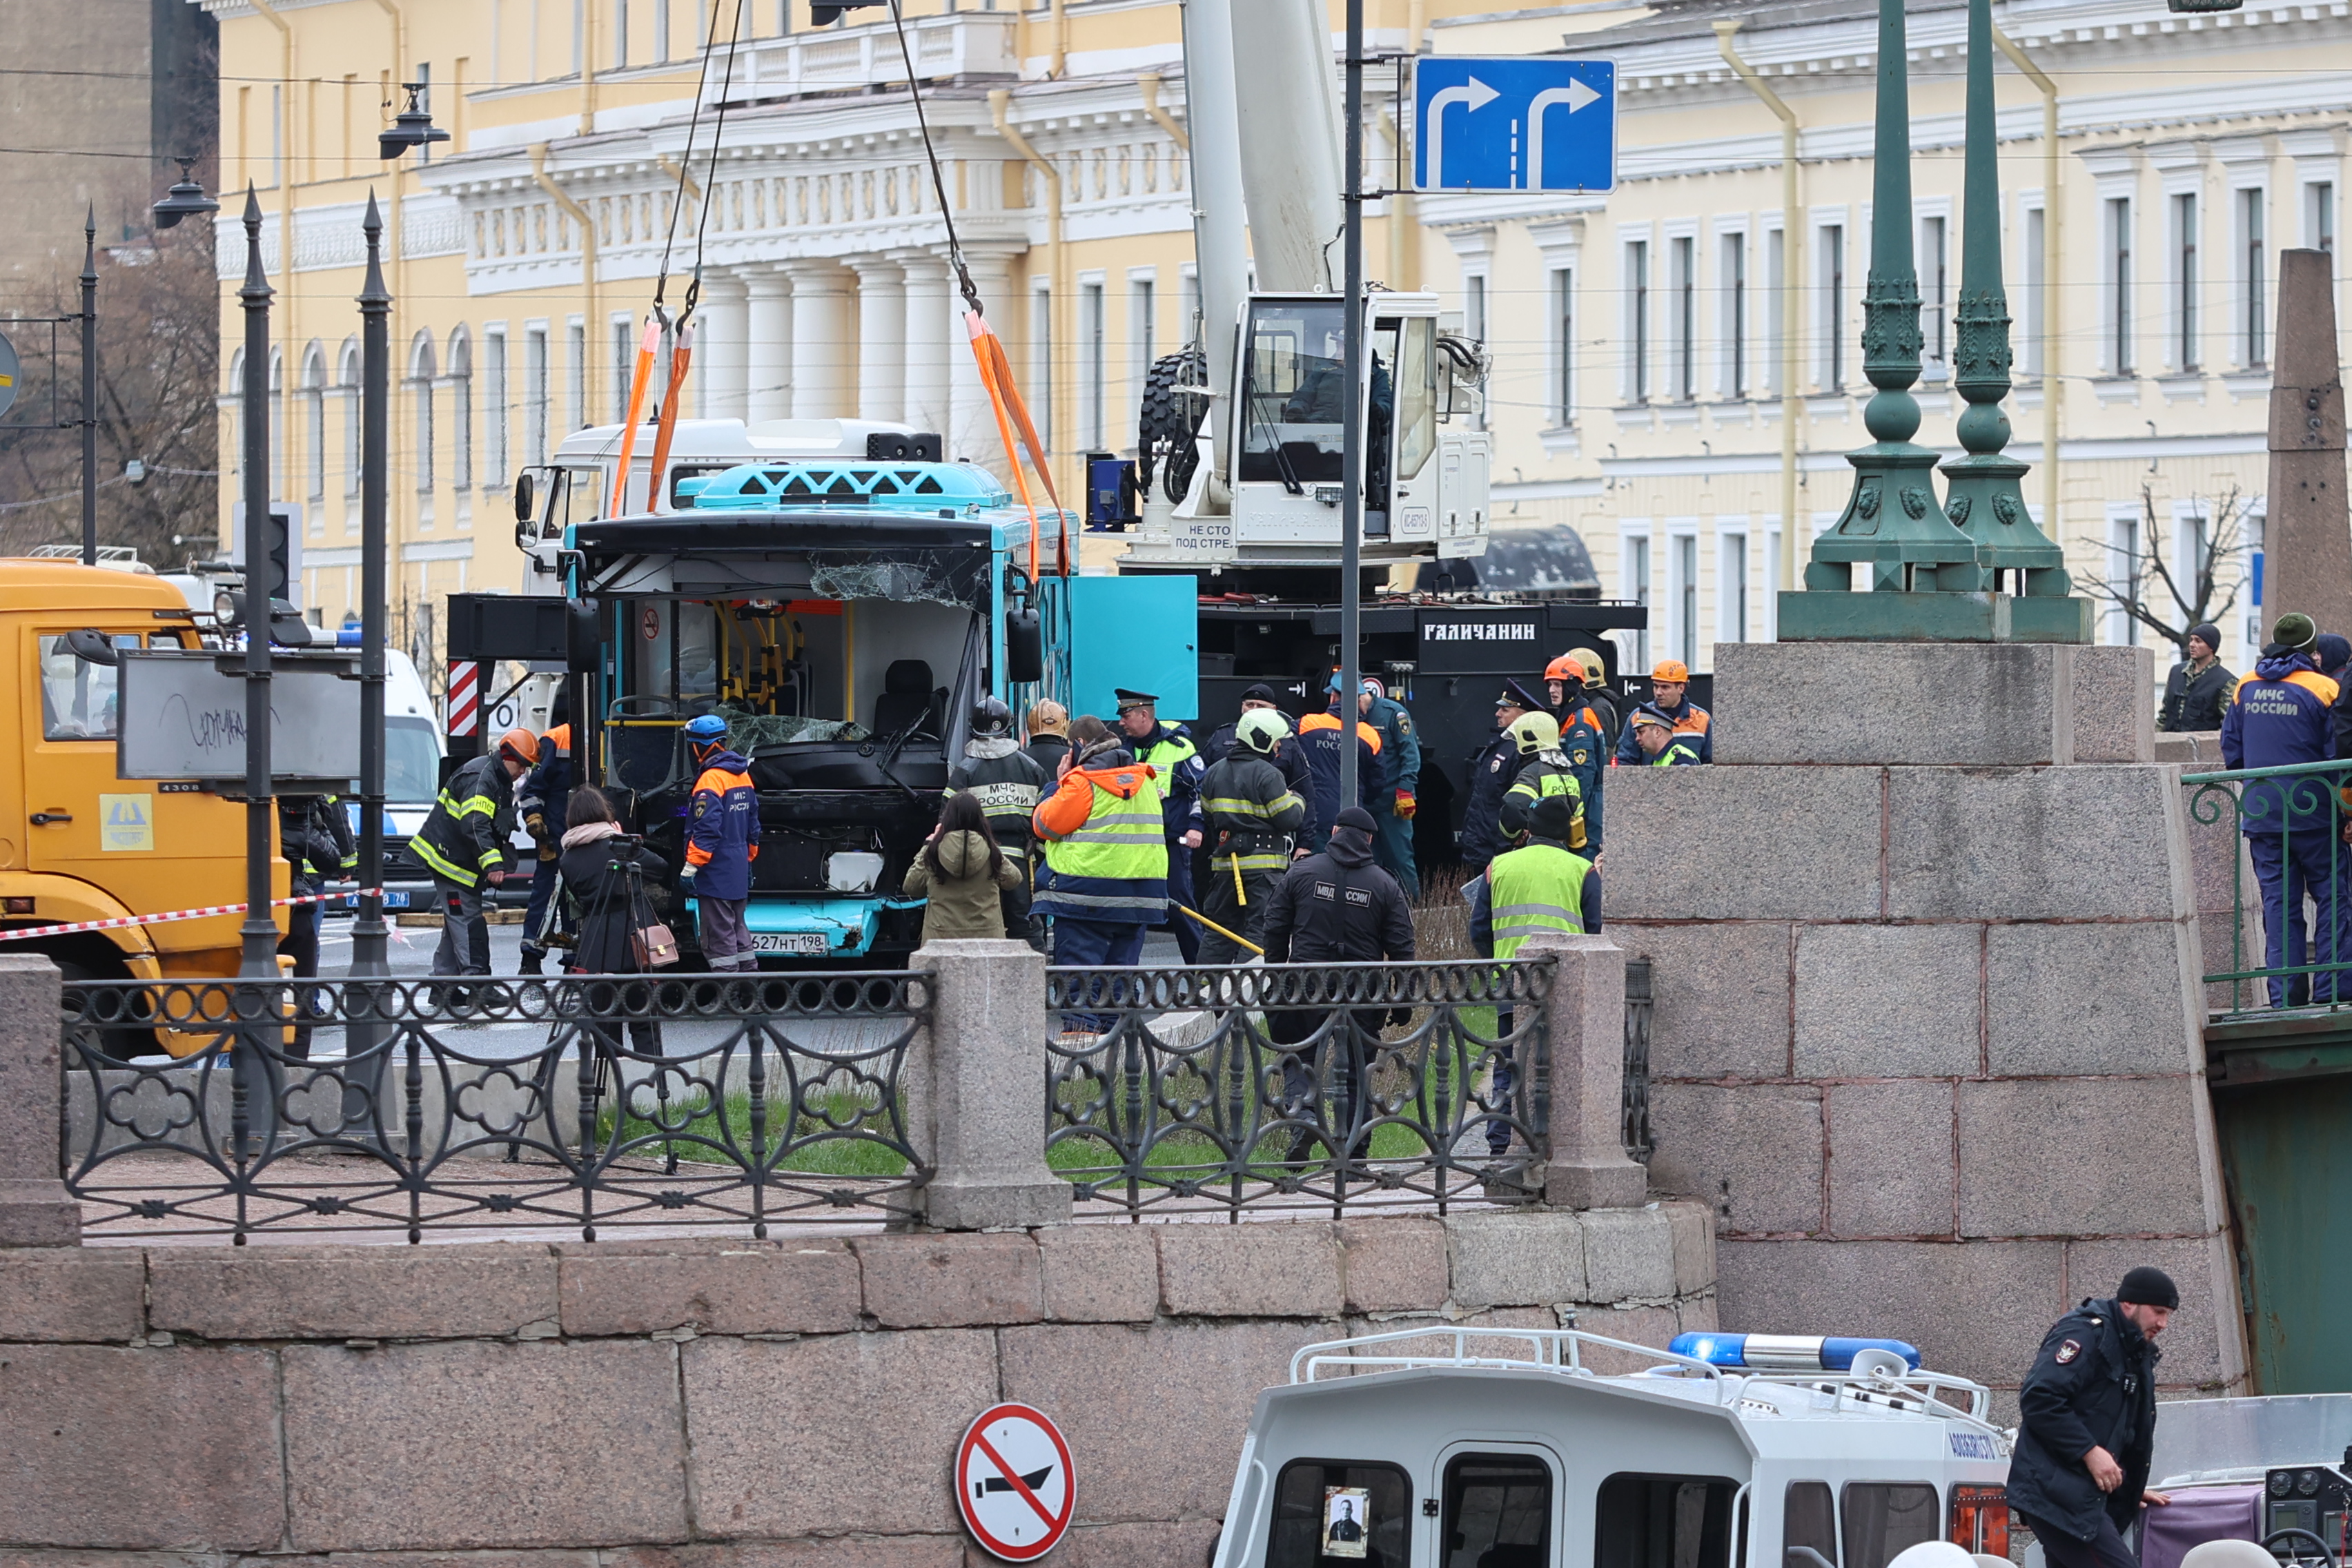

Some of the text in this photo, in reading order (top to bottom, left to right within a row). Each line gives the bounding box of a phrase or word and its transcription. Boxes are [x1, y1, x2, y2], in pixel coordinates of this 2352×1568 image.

[1190, 525, 1204, 535] НЕ
[1176, 538, 1237, 549] ПОД СТРЕ
[1424, 624, 1536, 640] ГАЛИЧАНИН
[2253, 689, 2285, 701] МЧС
[2245, 703, 2298, 716] РОССИИ
[990, 783, 1017, 794] МЧС
[978, 794, 1028, 805] РОССИИ
[1317, 885, 1335, 899] МВД
[800, 935, 821, 947] 198
